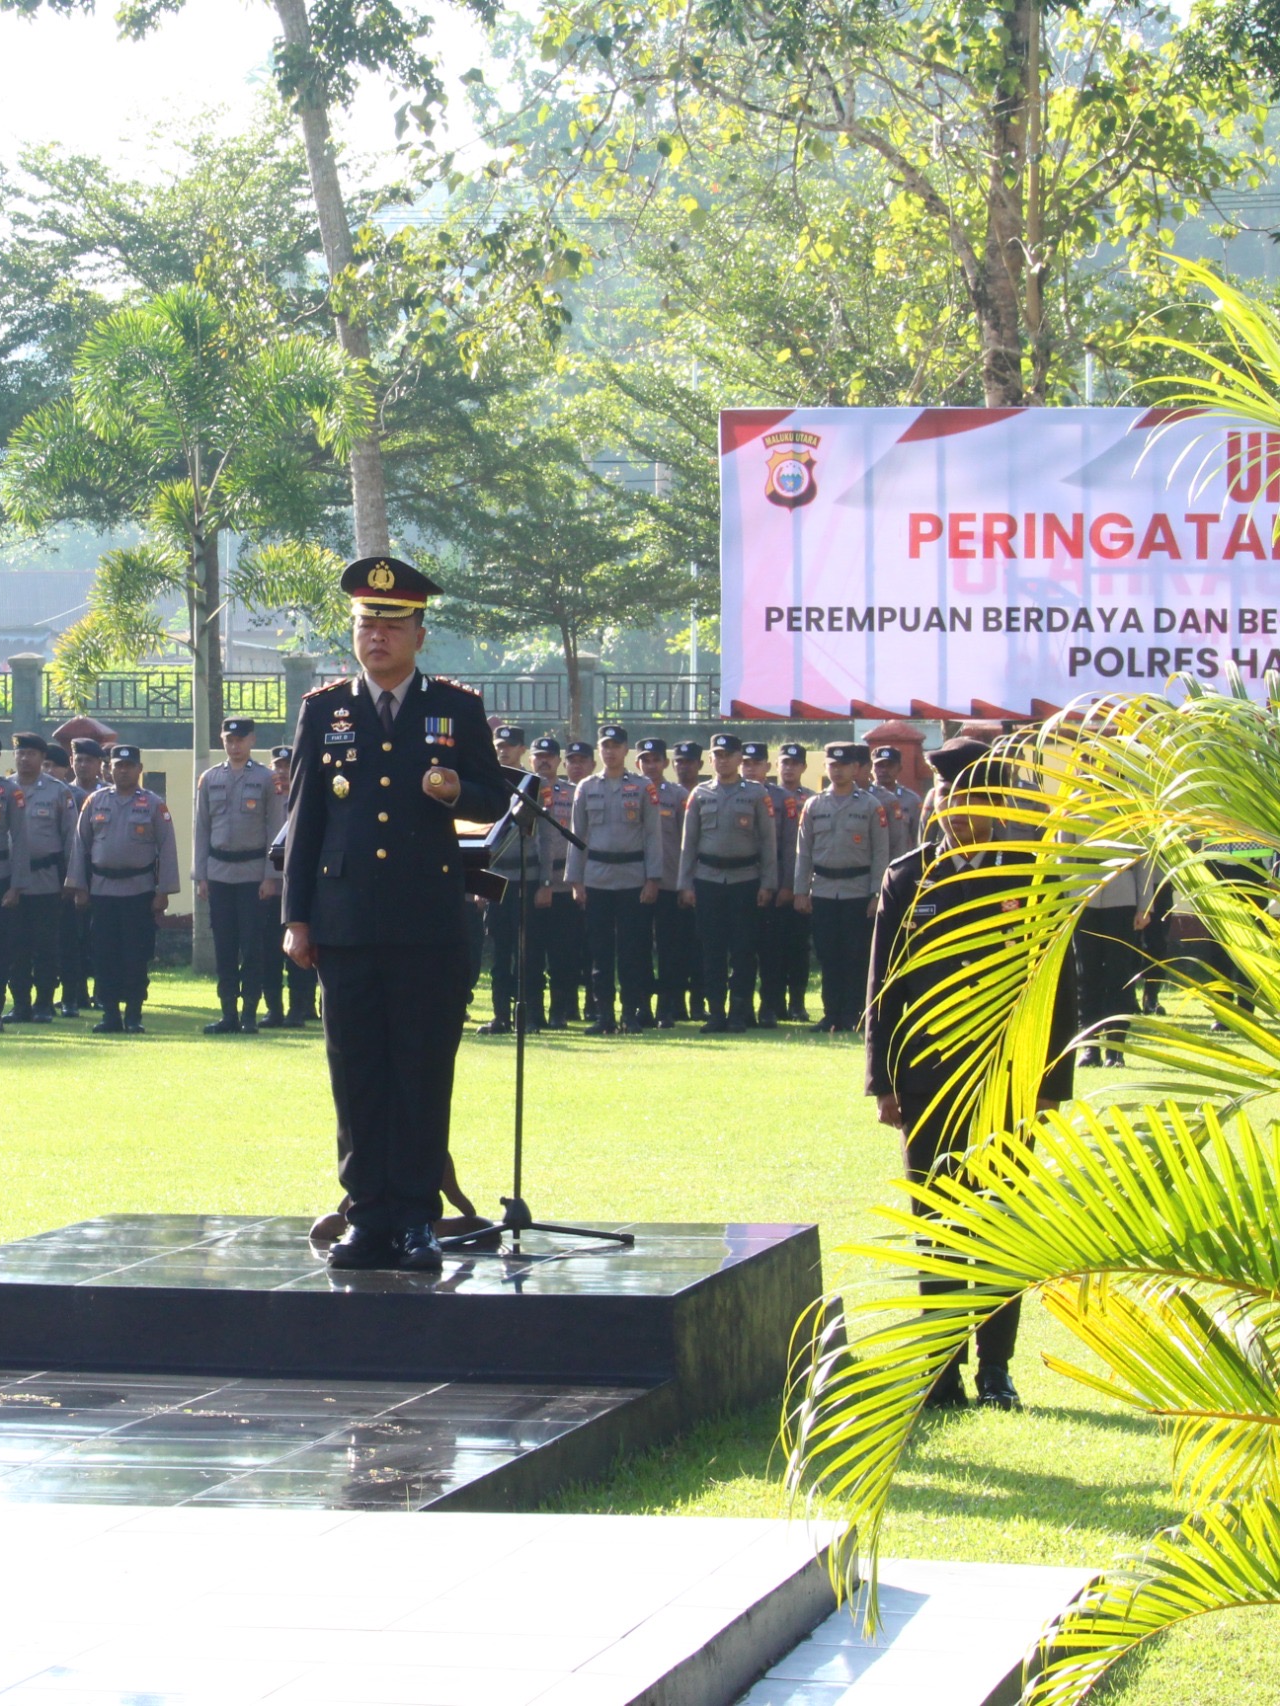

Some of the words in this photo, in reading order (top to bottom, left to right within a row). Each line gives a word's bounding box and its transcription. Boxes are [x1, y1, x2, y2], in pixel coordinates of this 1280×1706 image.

[765, 432, 794, 446] MALUKU
[795, 433, 818, 446] UTARA
[908, 512, 1280, 561] PERINGATA
[765, 606, 972, 632] PEREMPUAN
[982, 607, 1144, 633] BERDAYA
[1154, 608, 1228, 634] DAN
[1069, 647, 1219, 678] POLRES
